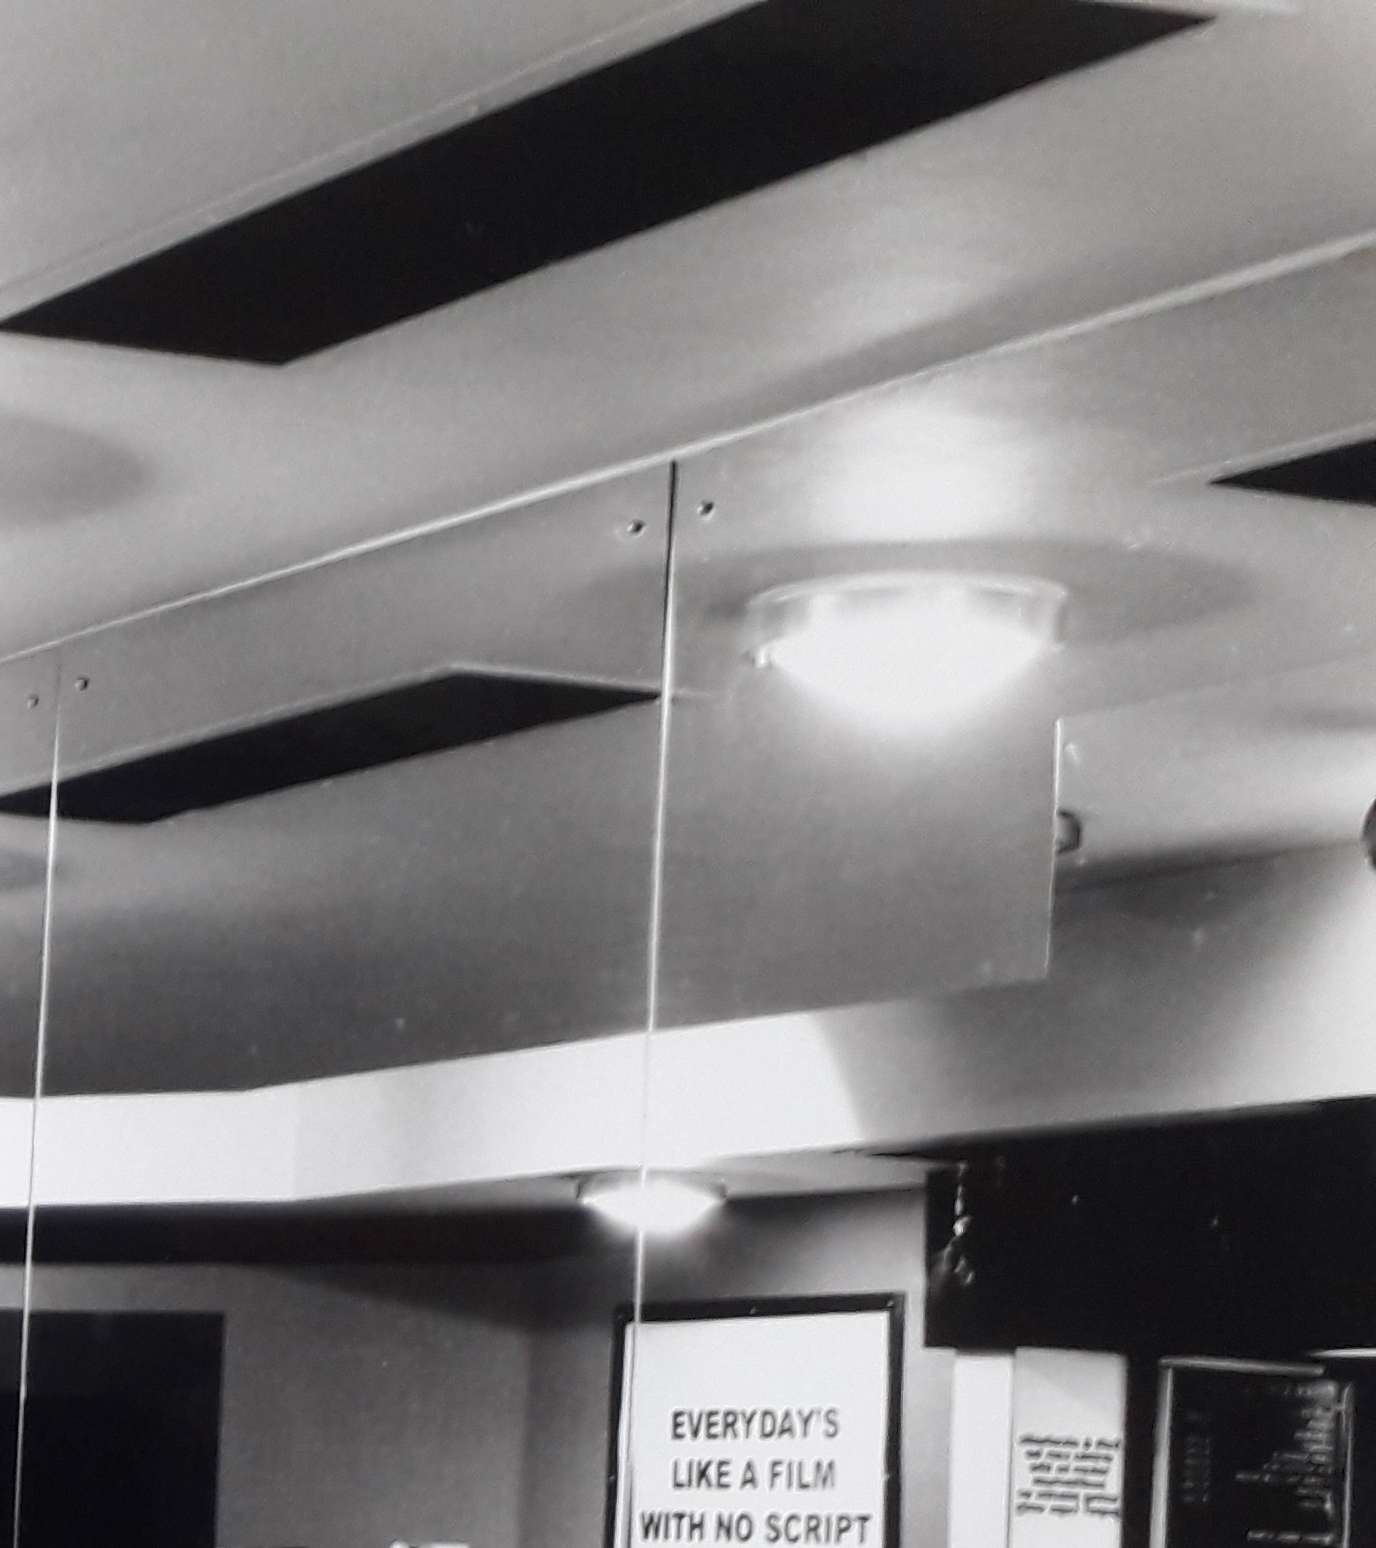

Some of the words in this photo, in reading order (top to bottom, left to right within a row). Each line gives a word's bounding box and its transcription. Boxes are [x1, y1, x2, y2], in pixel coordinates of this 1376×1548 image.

[671, 1407, 840, 1440] EVERYDAY'S
[673, 1459, 732, 1490] LIKE
[739, 1459, 758, 1490] A
[769, 1459, 836, 1490] FILM
[641, 1510, 704, 1542] WITH
[715, 1511, 753, 1543] NO
[765, 1512, 872, 1545] SCRIPT
